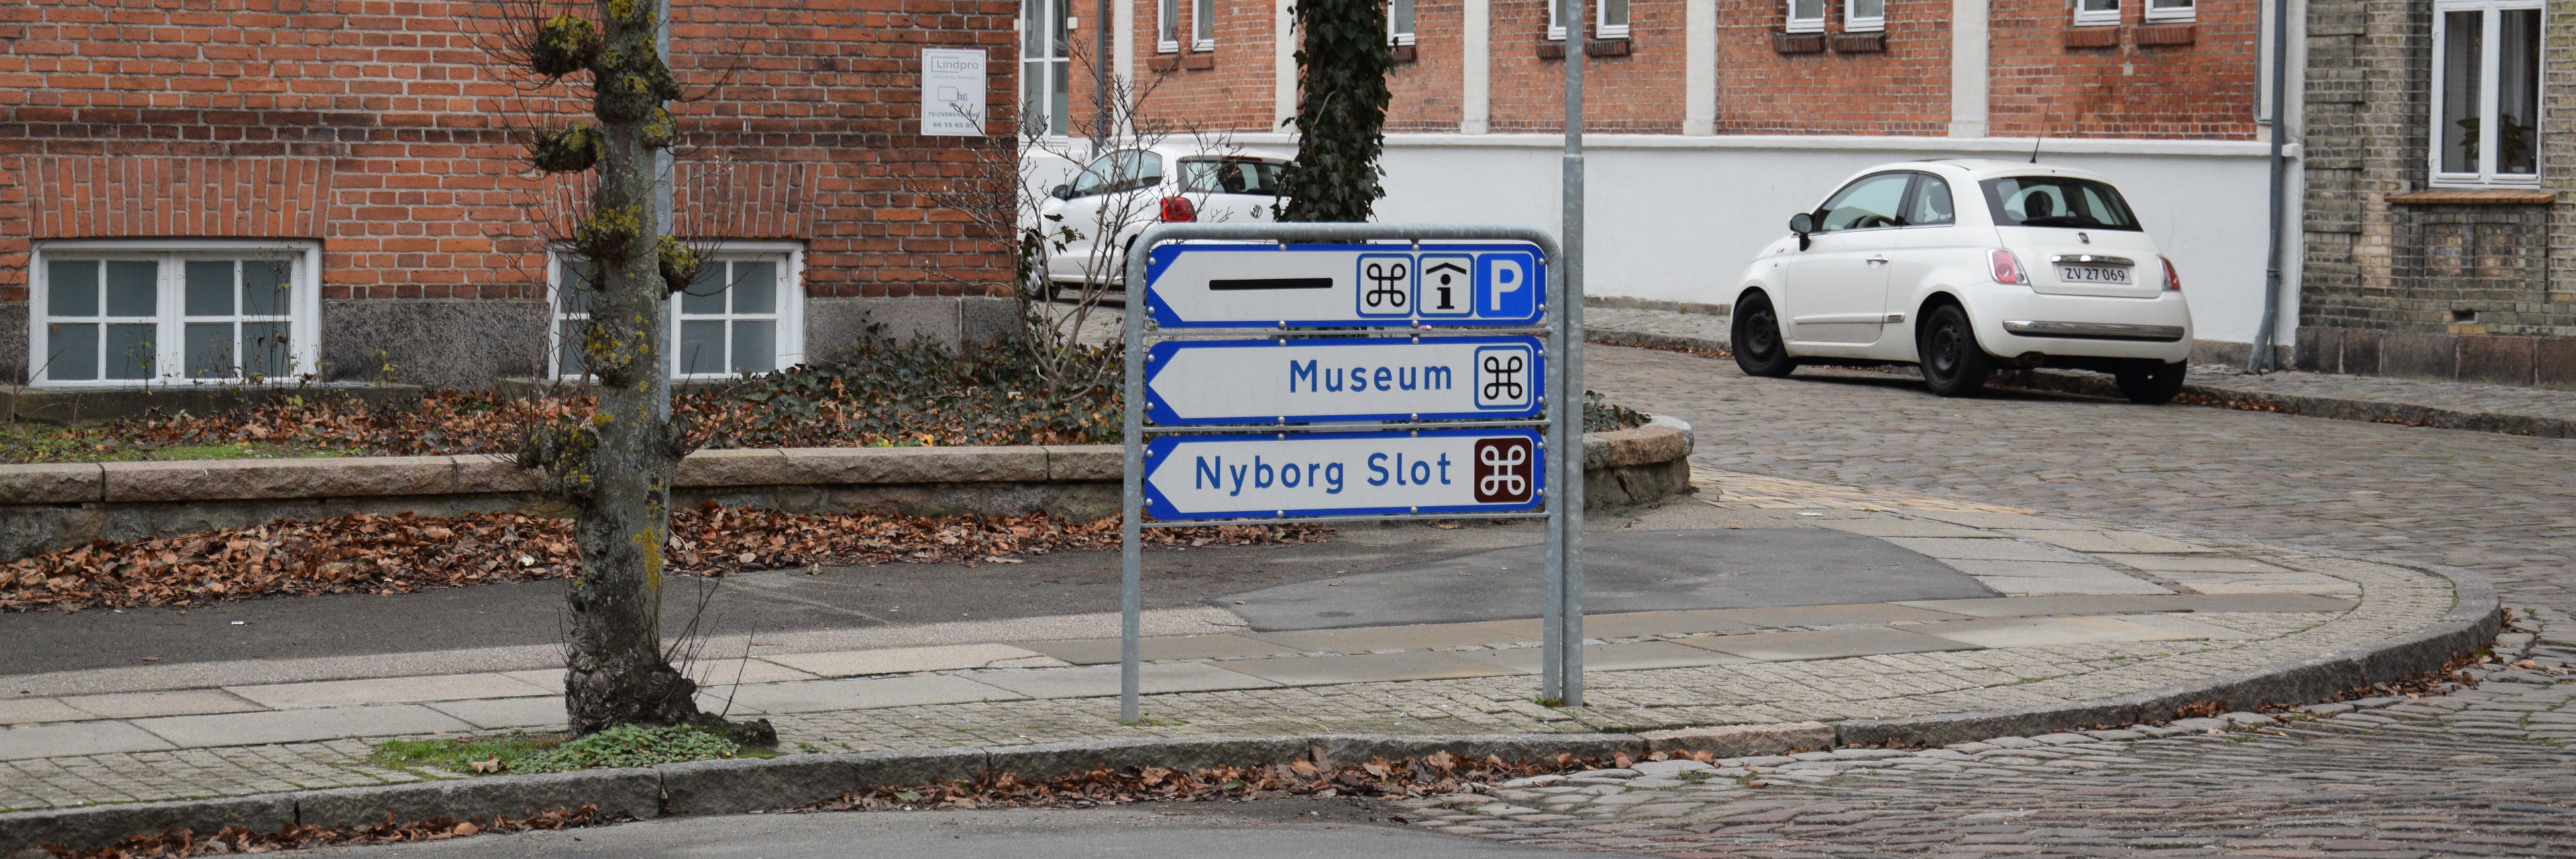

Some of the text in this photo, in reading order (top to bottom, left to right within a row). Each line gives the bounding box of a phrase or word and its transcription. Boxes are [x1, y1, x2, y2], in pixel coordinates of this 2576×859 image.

[936, 60, 979, 71] Lindpro
[2064, 268, 2125, 281] ZV 27 069
[1289, 359, 1452, 393] Museum
[1195, 452, 1452, 497] Nyborg Slot
